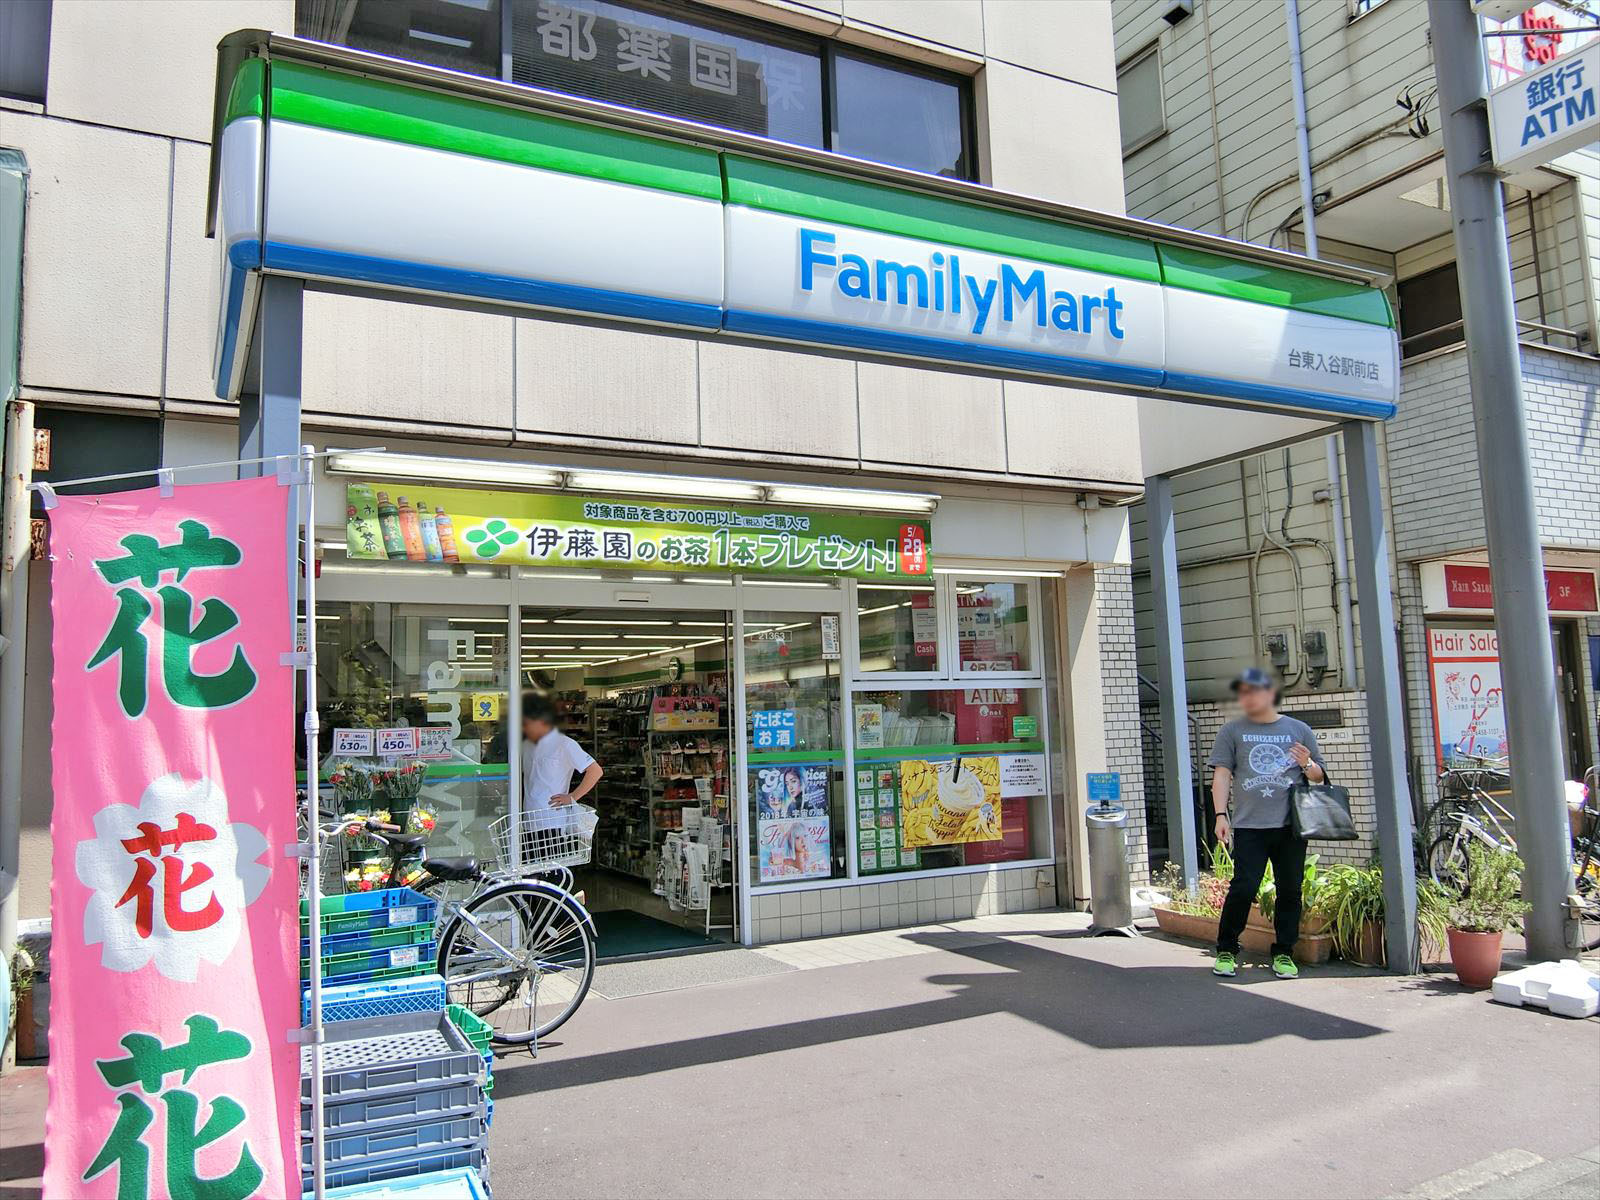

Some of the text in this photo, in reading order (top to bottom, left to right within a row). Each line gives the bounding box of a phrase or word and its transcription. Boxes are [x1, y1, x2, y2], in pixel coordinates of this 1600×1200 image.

[536, 4, 805, 112] 都薬国保
[1526, 59, 1585, 110] 銀行
[1521, 88, 1596, 147] ATM
[800, 227, 1125, 340] FamilyMart
[1288, 348, 1379, 380] 台東入谷駅前店
[903, 538, 922, 556] 28
[1559, 586, 1571, 597] 3F
[85, 518, 257, 720] 花
[916, 645, 935, 653] Cash
[1434, 633, 1464, 651] Hair
[754, 712, 795, 727] たばこ
[758, 730, 791, 746] お酒
[114, 812, 225, 939] 花
[337, 920, 369, 929] FamilyMart
